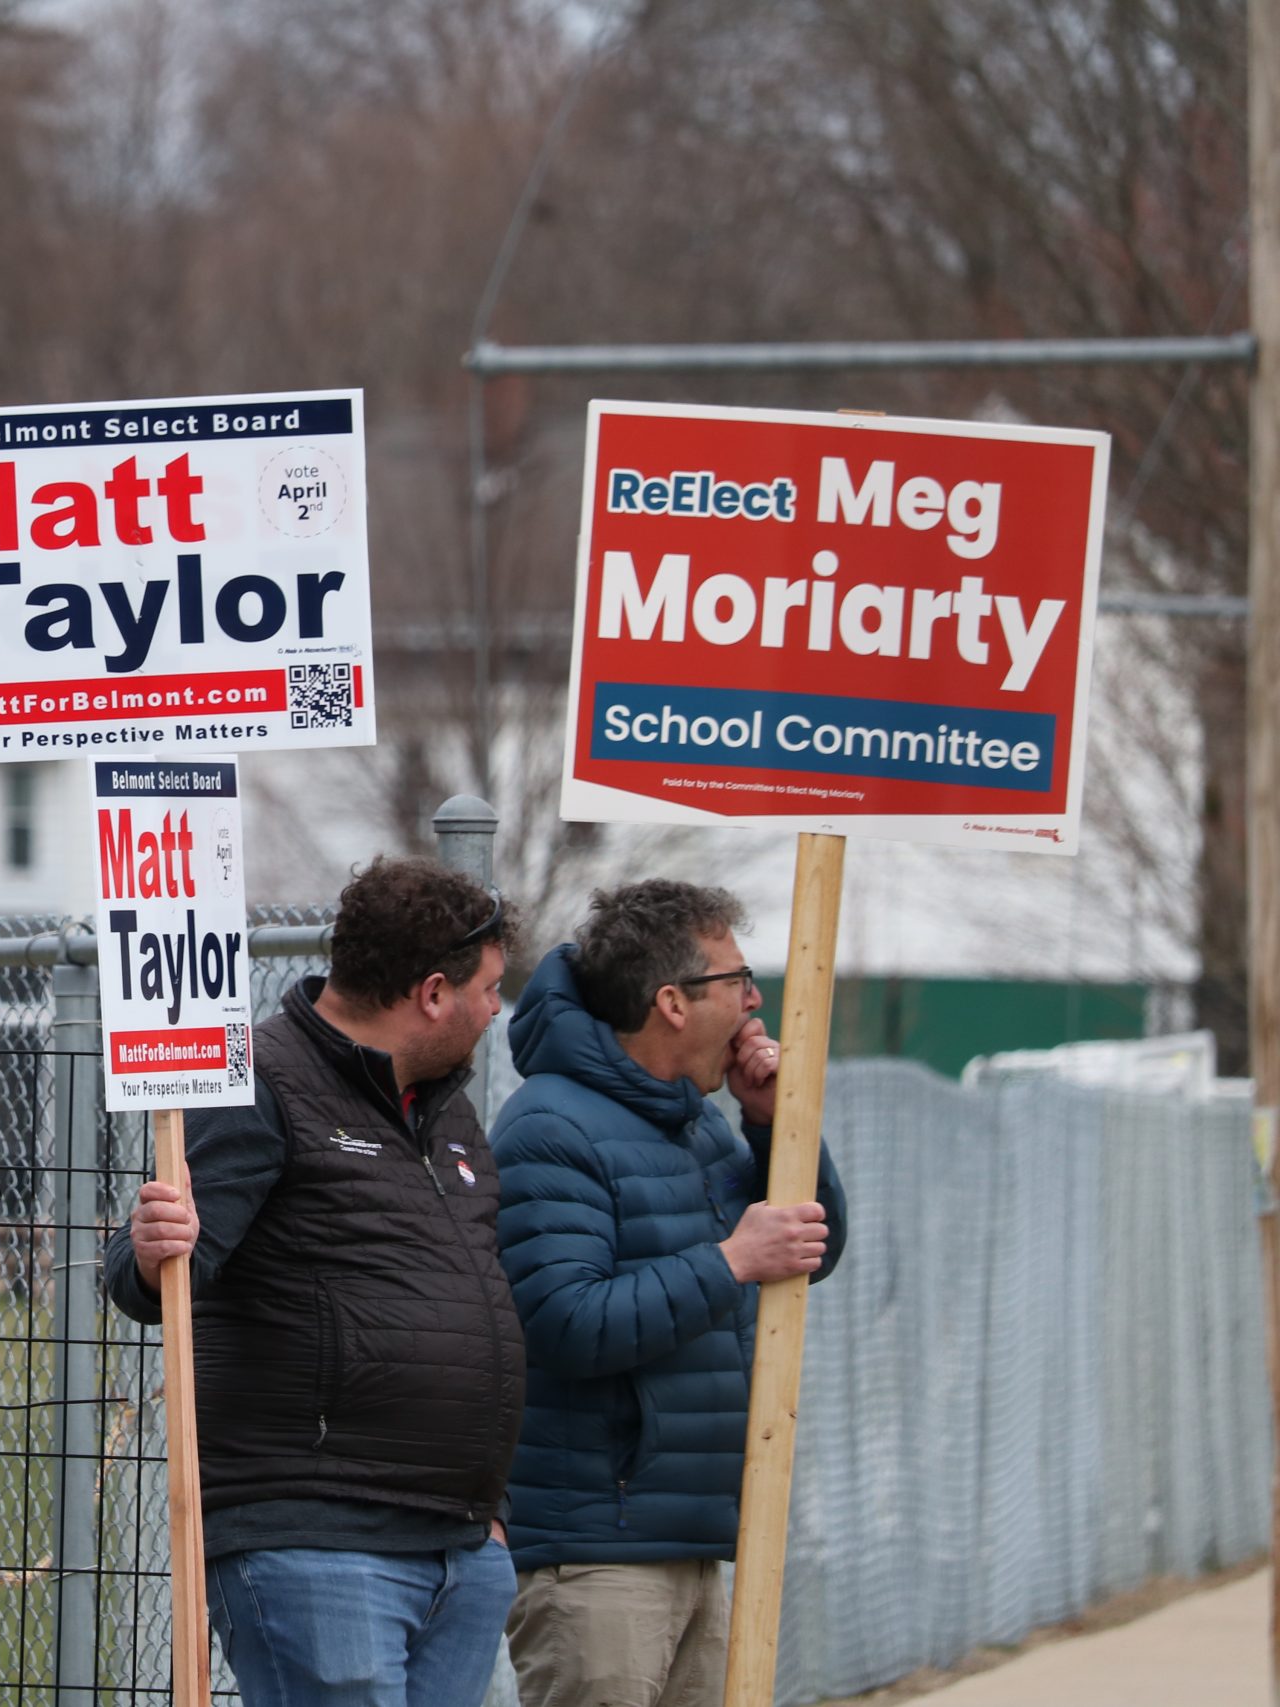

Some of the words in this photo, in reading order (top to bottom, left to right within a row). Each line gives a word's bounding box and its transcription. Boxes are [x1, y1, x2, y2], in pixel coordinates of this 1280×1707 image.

[104, 414, 199, 438] Select
[213, 409, 301, 433] Board
[285, 465, 319, 478] vote
[278, 482, 327, 502] April
[610, 470, 794, 519] ReElect
[817, 456, 1002, 559] Meg
[597, 550, 1066, 691] Moriarty
[22, 725, 165, 748] Perspective
[175, 723, 268, 741] Matters
[604, 704, 763, 749] School
[776, 714, 1040, 772] Committee
[112, 770, 155, 790] Belmont
[158, 771, 190, 790] Select
[192, 771, 222, 790] Board
[663, 778, 682, 787] Paid
[683, 778, 695, 787] for
[697, 779, 707, 790] by
[709, 780, 724, 789] the
[725, 781, 775, 793] Committee
[775, 785, 785, 793] to
[786, 785, 808, 795] Elect
[809, 787, 828, 798] Meg
[829, 789, 864, 801] Moriarty
[98, 808, 196, 899] Matt
[109, 909, 241, 1025] Taylor
[119, 1042, 221, 1063] MattForBelmont.com
[122, 1081, 140, 1096] Your
[143, 1080, 189, 1098] Perspective
[192, 1079, 222, 1094] Matters
